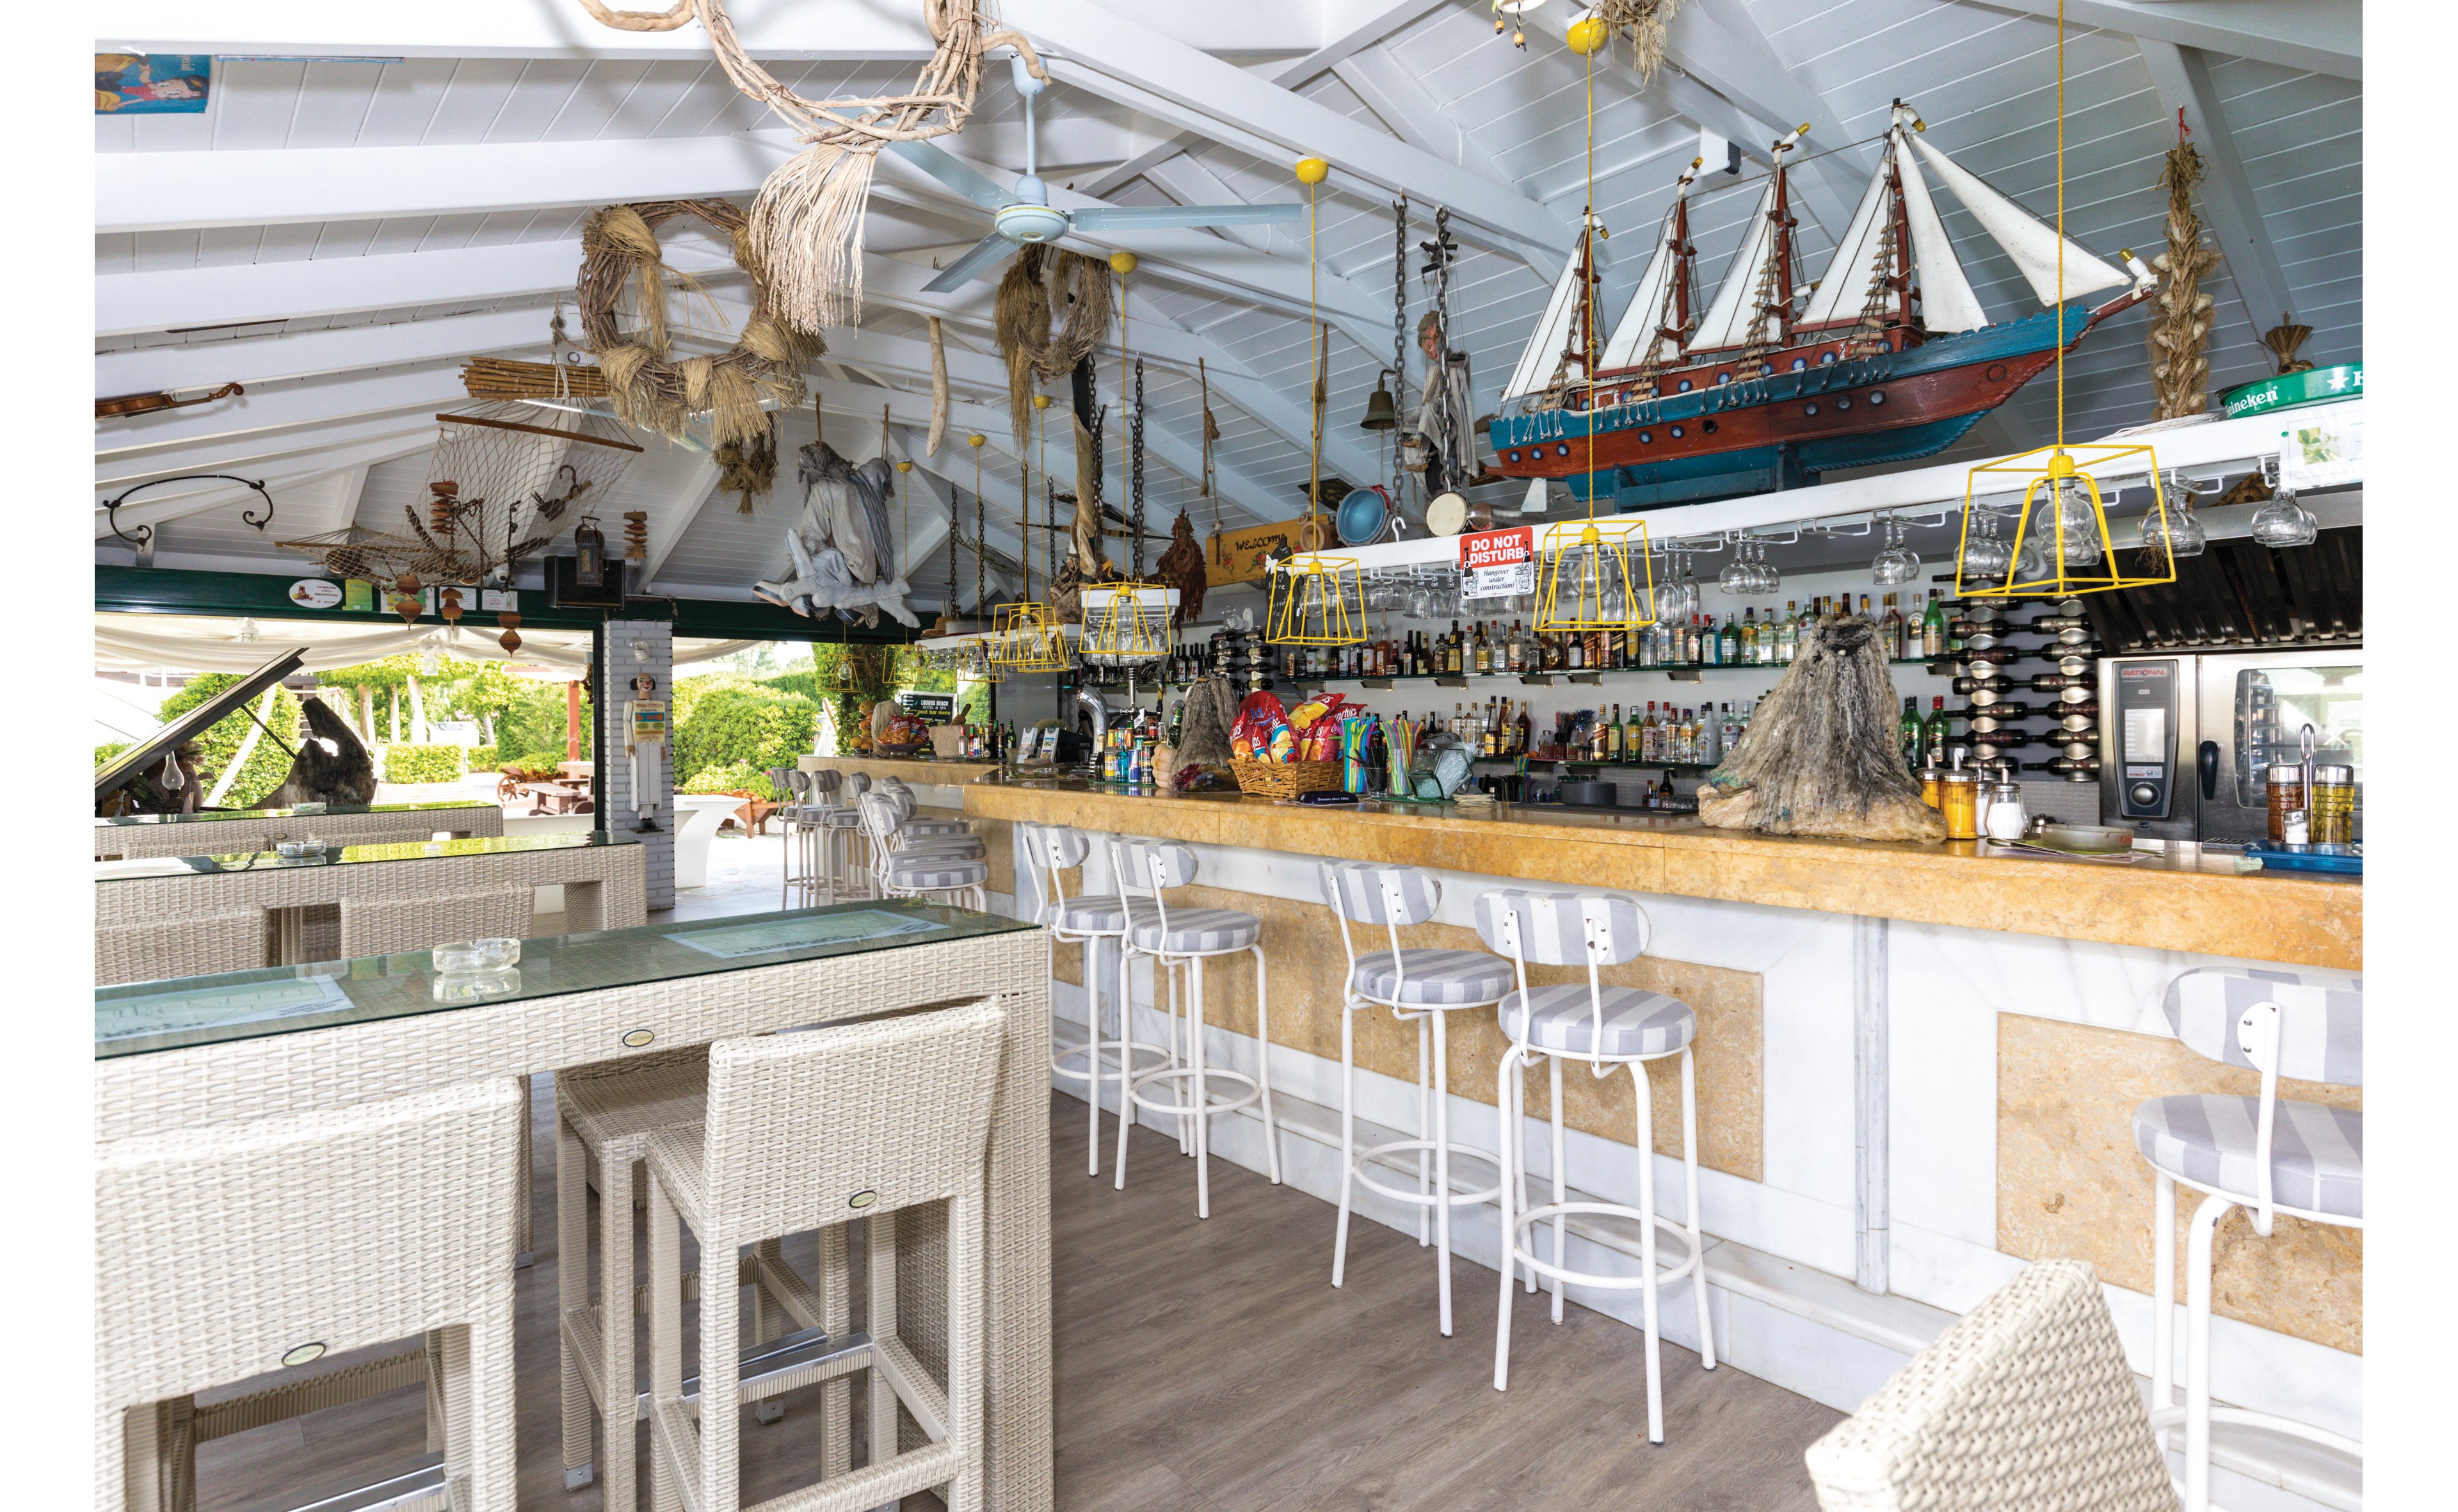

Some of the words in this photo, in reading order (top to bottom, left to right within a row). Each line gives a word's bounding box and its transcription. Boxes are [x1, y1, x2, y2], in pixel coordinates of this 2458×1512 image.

[1472, 538, 1490, 552] DO
[1493, 535, 1522, 549] NOT
[1470, 547, 1524, 564] DISTURB
[1480, 582, 1515, 591] construction!
[2123, 668, 2167, 677] RATIONAL
